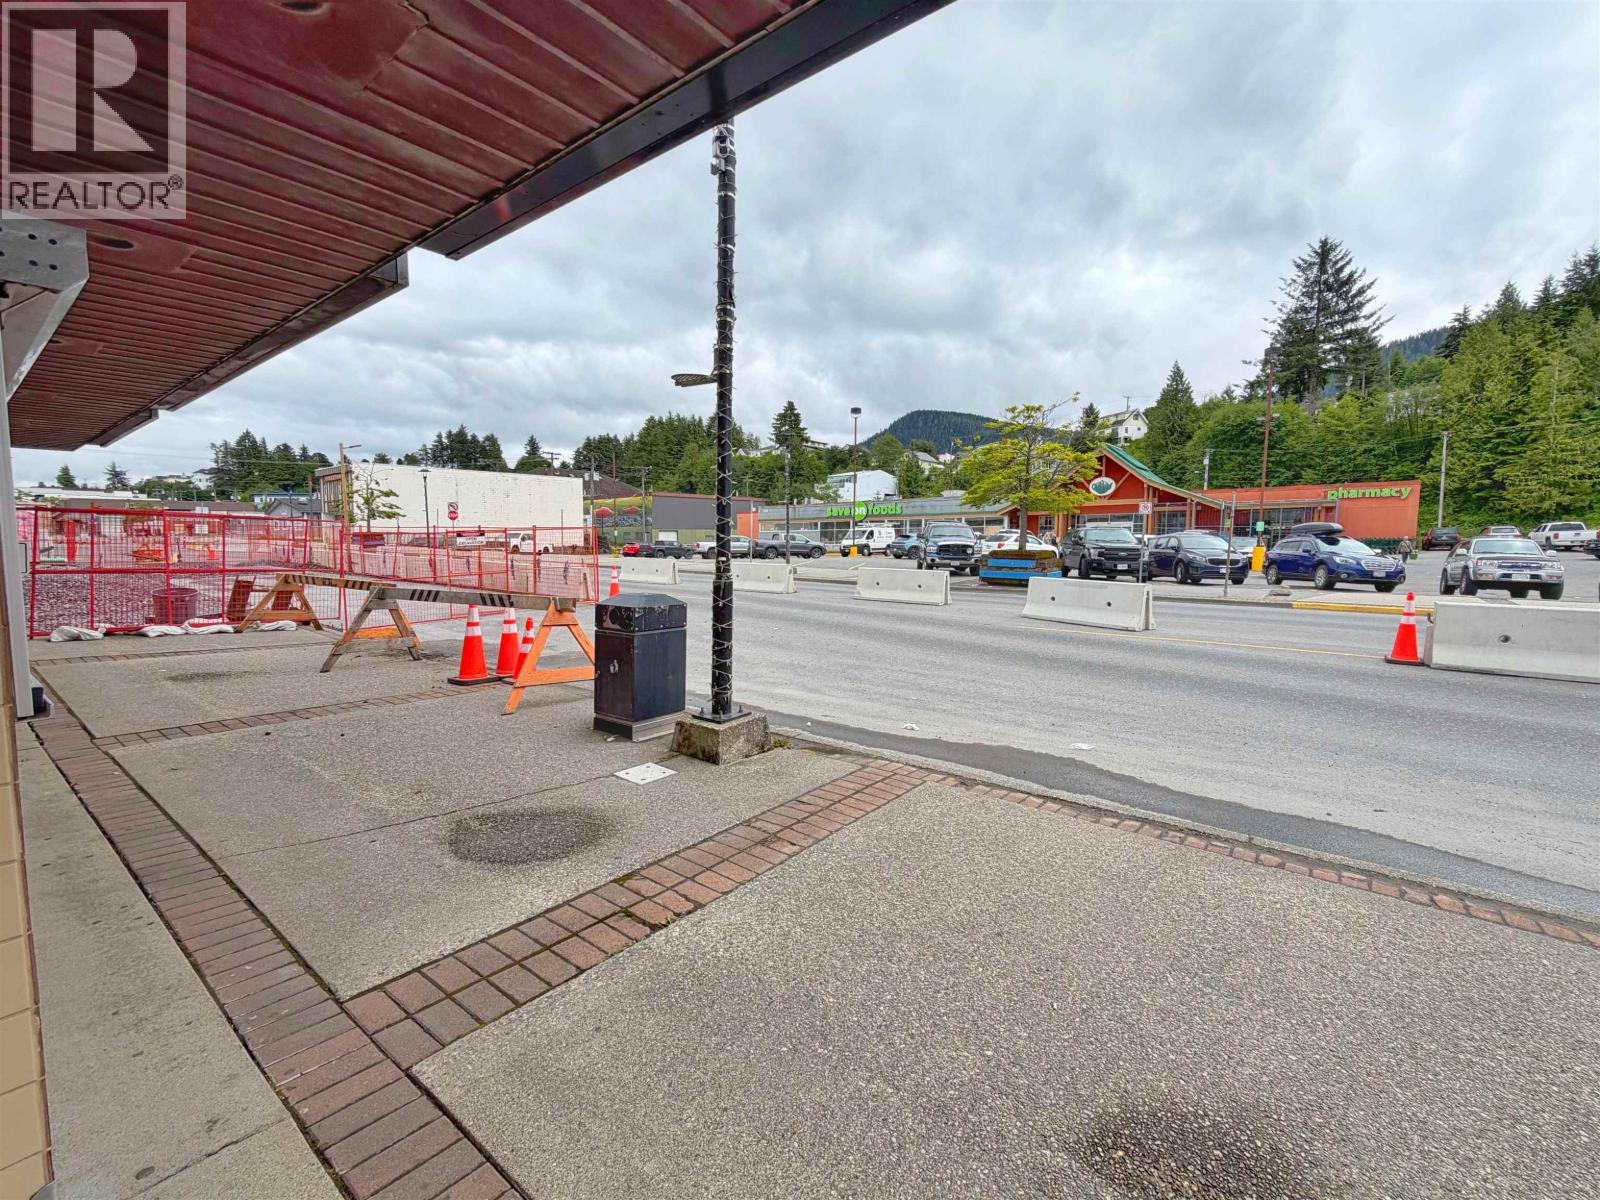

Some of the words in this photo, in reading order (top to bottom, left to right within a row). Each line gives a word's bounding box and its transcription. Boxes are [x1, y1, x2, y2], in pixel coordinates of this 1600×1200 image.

[1327, 487, 1412, 501] pharmacy
[826, 506, 851, 517] save
[867, 502, 902, 515] foods
